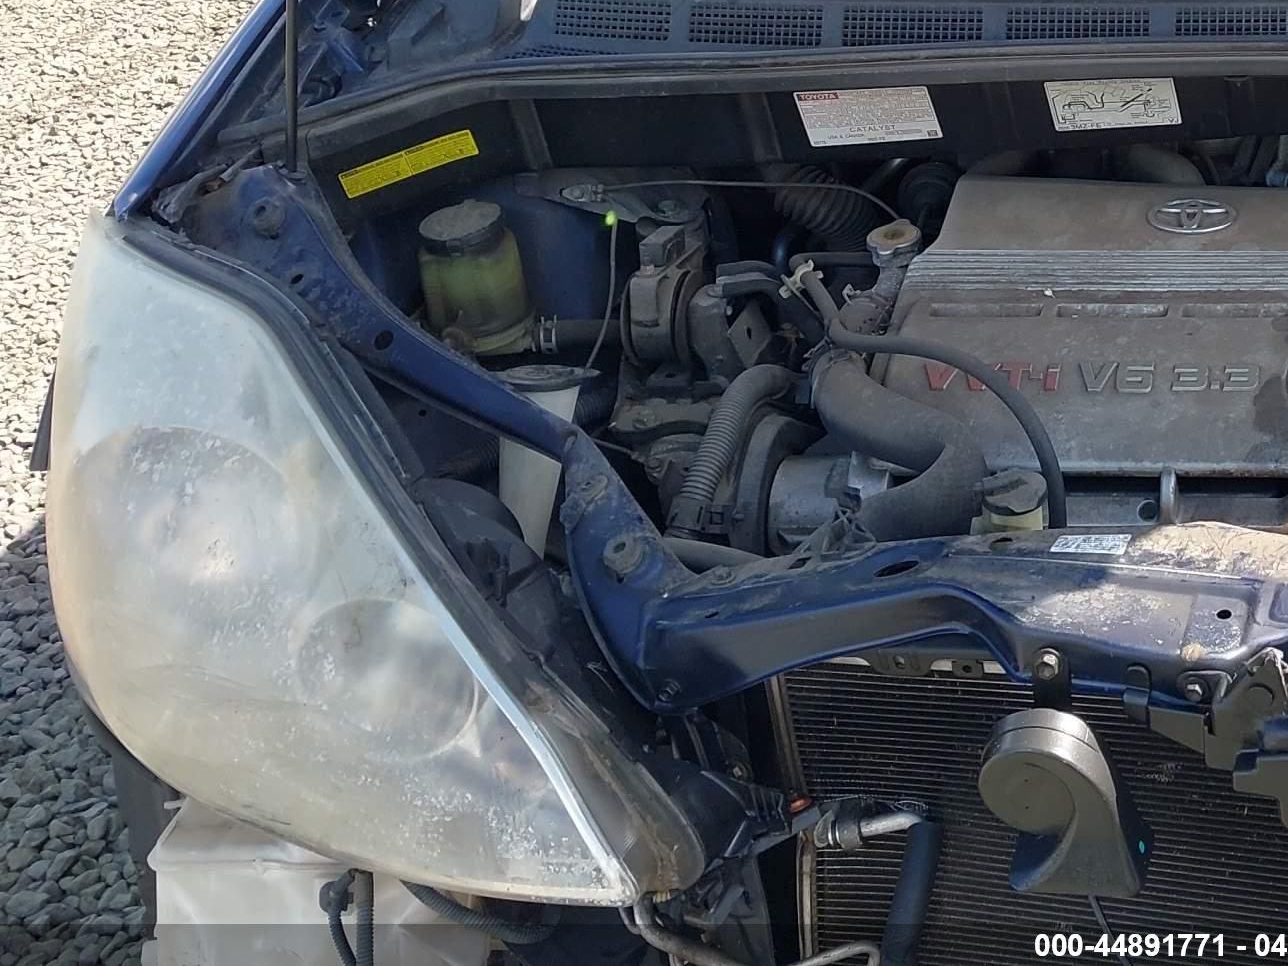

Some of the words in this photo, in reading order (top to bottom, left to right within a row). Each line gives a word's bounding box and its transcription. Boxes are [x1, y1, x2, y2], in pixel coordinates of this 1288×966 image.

[849, 124, 896, 133] CATALYST
[1078, 361, 1156, 393] V6
[1171, 364, 1261, 393] 3.3
